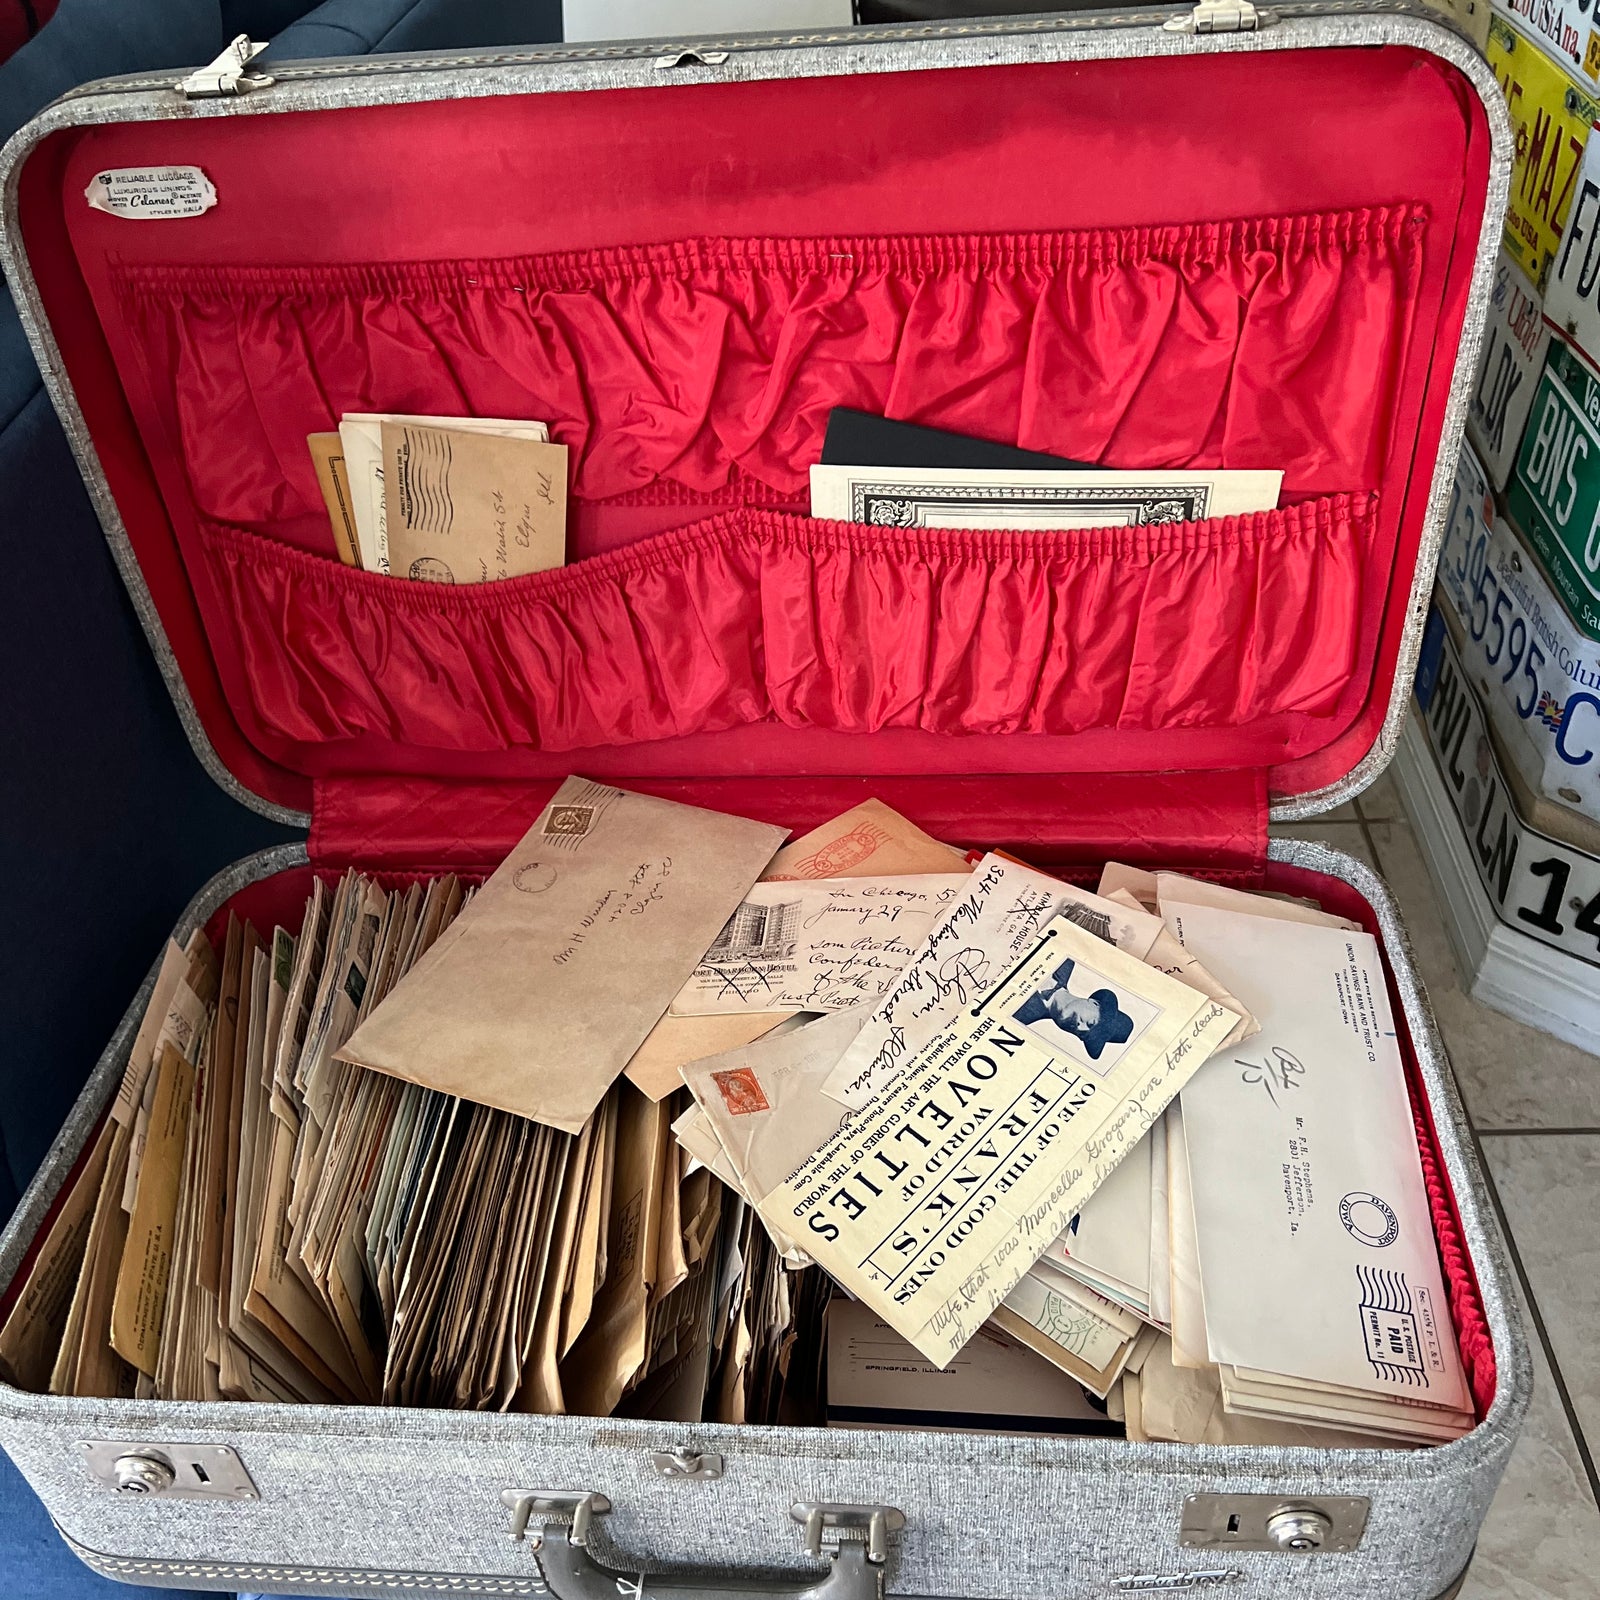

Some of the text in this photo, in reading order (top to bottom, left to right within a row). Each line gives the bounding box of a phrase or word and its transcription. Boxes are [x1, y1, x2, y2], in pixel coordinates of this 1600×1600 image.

[116, 172, 196, 184] RELIABLE LUGGAGE
[1520, 107, 1583, 239] MAZ
[113, 186, 158, 195] LUXURIOUS
[1527, 390, 1588, 526] BNS
[1529, 605, 1559, 658] British
[1008, 925, 1031, 952] HOUSE
[1345, 942, 1356, 963] UNION
[766, 963, 798, 972] HOTEL
[1349, 964, 1361, 992] SAVINGS
[1355, 992, 1365, 1011] BANK
[968, 1015, 996, 1043] HERE
[1341, 1008, 1349, 1025] IOWA
[1359, 1011, 1368, 1026] AND
[1370, 1010, 1378, 1030] RETURN
[924, 1031, 958, 1065] Delightful
[1362, 1027, 1373, 1049] TRUST
[937, 1040, 973, 1073] DWELL
[903, 1061, 929, 1082] Music,
[918, 1072, 942, 1094] THE
[881, 1081, 909, 1107] Feature
[898, 1091, 921, 1115] ART
[806, 1023, 1028, 1244] NOVELTIES
[860, 1112, 902, 1152] GLORIES
[809, 1140, 847, 1176] Laughable
[848, 1148, 865, 1166] OF
[899, 1104, 994, 1203] WORLD OF
[1288, 1138, 1299, 1160] 2801
[782, 1154, 817, 1185] Detective
[826, 1162, 852, 1185] THE
[890, 1088, 1050, 1258] FRANK'S
[791, 1181, 832, 1218] WORLD
[892, 1081, 1097, 1306] ONE OF THE GOOD ONES
[1339, 1198, 1354, 1232] IOWA
[1369, 1195, 1398, 1247] DAVENPORT
[1369, 1310, 1381, 1338] PERMIT
[1386, 1326, 1404, 1354] PAID
[1403, 1334, 1417, 1364] POSTAGE
